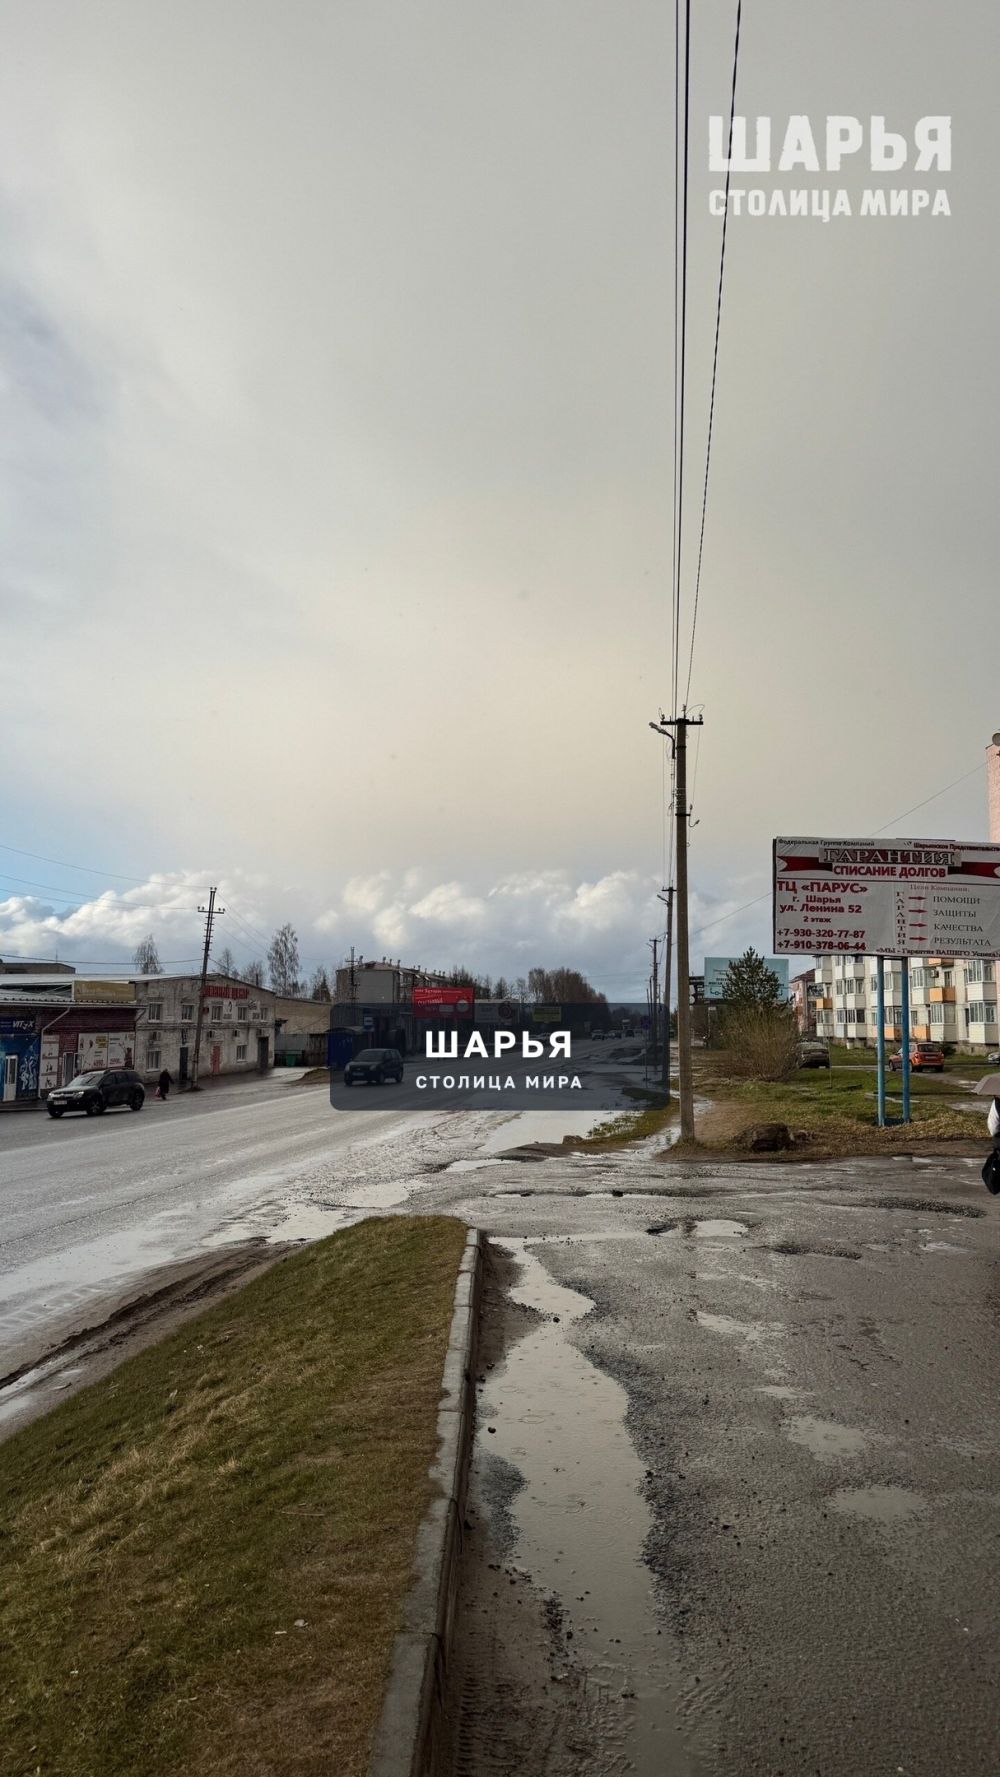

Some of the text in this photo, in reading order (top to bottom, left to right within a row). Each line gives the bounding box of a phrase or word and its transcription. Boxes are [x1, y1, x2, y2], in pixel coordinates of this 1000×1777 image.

[823, 848, 954, 865] ГАРАНТИЯ
[833, 865, 946, 879] СПИСАНИЕ ДОЛГОВ
[777, 880, 868, 894] ТЦ «ПАРУС»
[806, 895, 841, 904] Шарья
[933, 896, 981, 905] ПОМОЩИ
[779, 903, 862, 914] ул. Ленина 52
[933, 909, 977, 918] ЗАЩИТЫ
[777, 928, 866, 938] +7-930-320-77-87
[934, 924, 984, 932] КАЧЕСТВА
[777, 940, 867, 950] +7-910-378-06-44
[934, 937, 992, 946] РЕЗУЛЬТАТА
